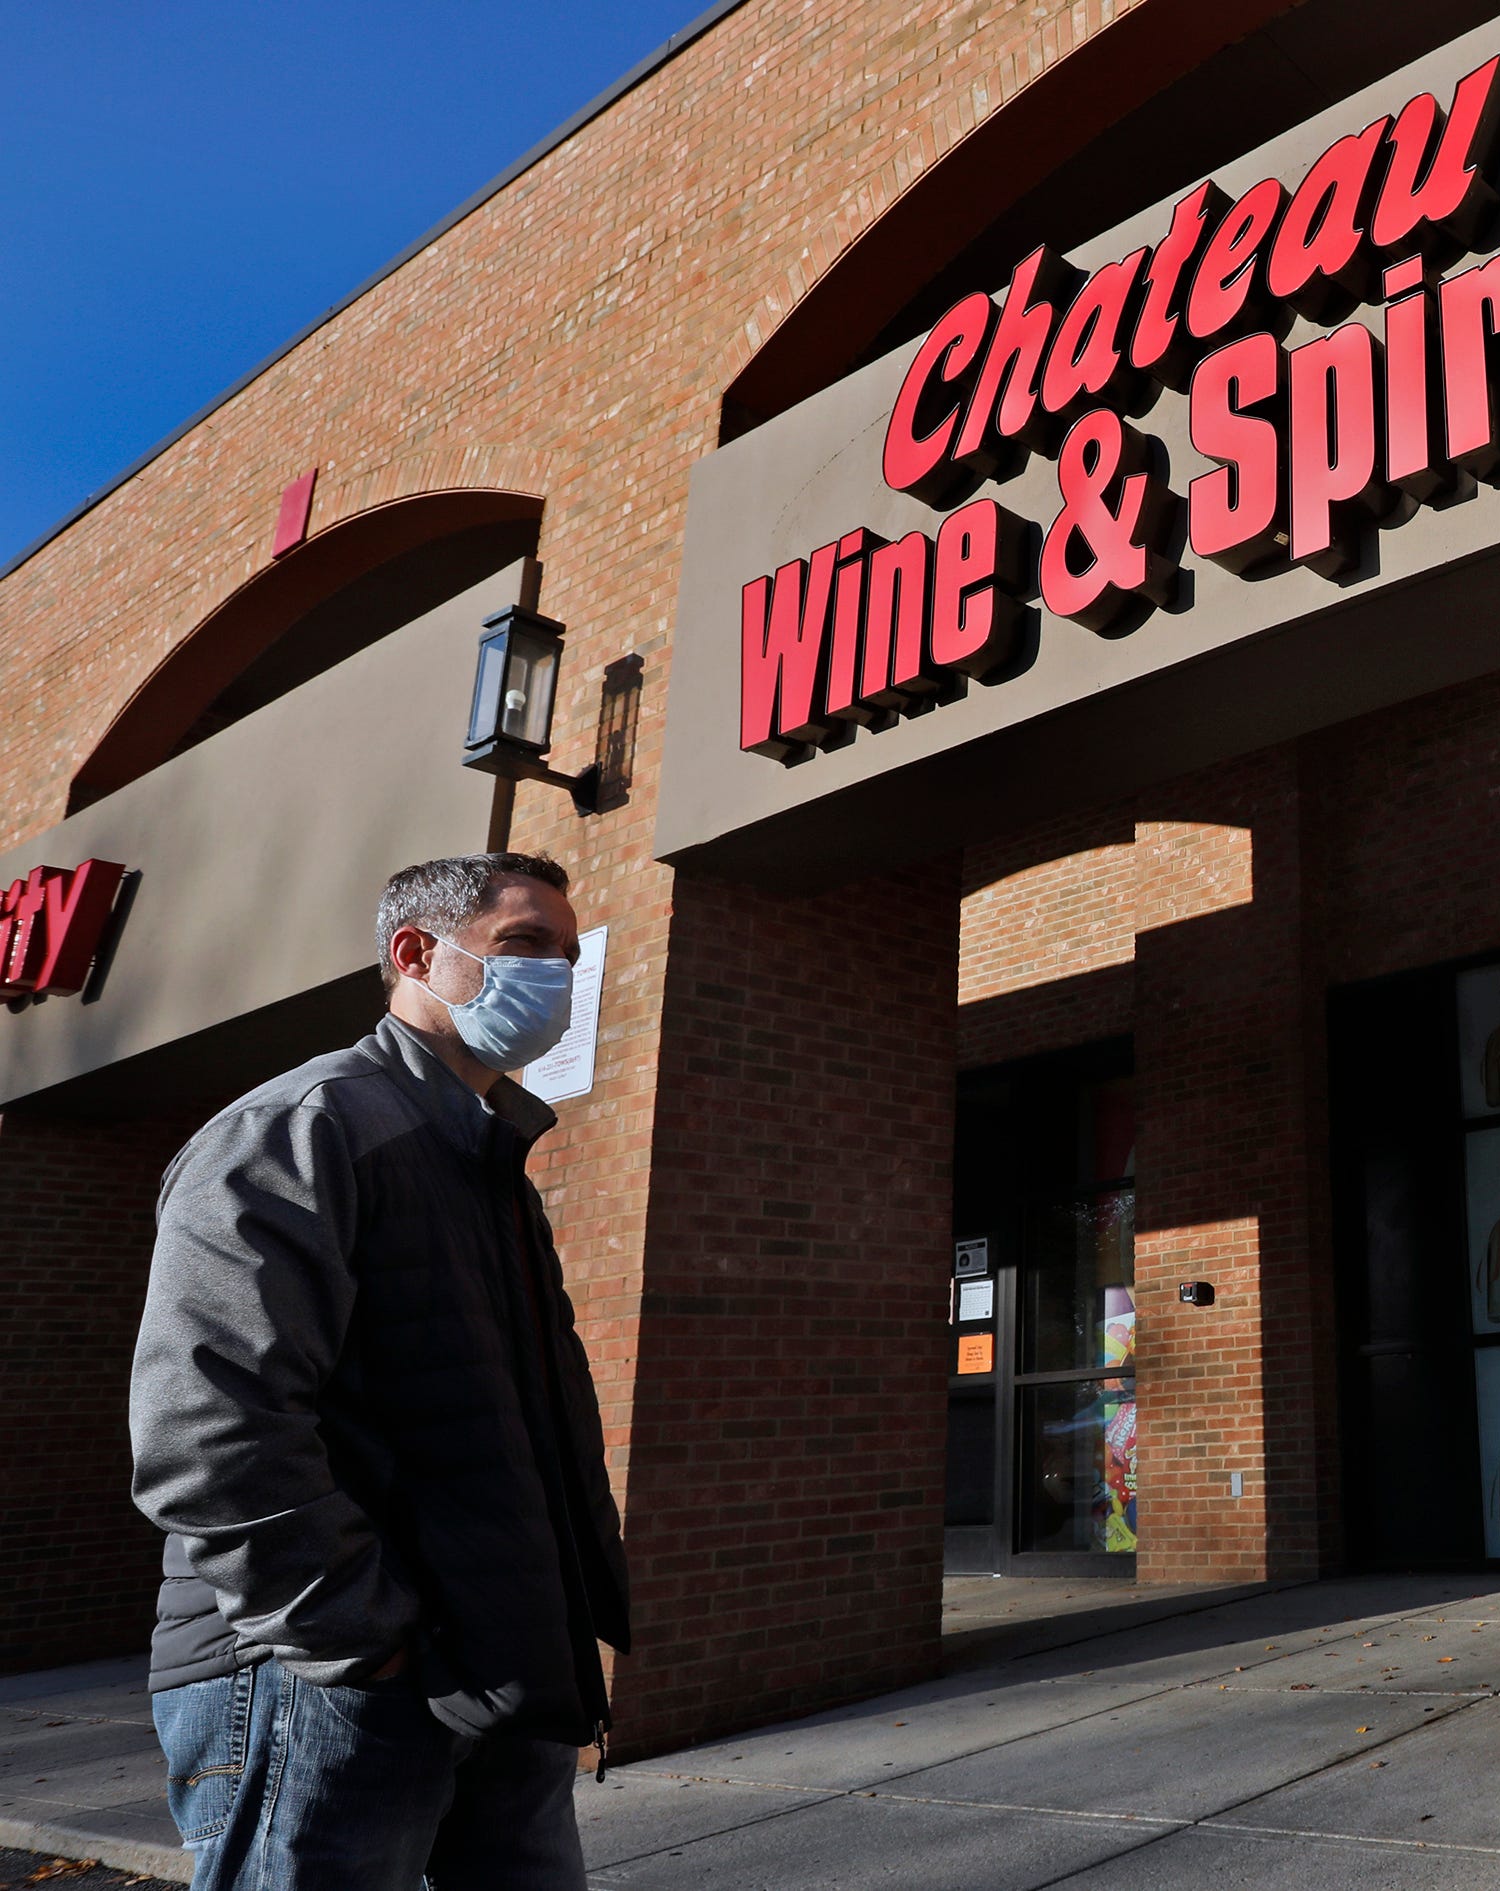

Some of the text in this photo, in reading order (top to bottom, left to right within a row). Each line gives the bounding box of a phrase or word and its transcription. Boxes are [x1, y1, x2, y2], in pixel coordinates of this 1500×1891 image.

[739, 497, 1000, 753] Wine
[1037, 406, 1150, 618] &
[0, 859, 95, 994] ity
